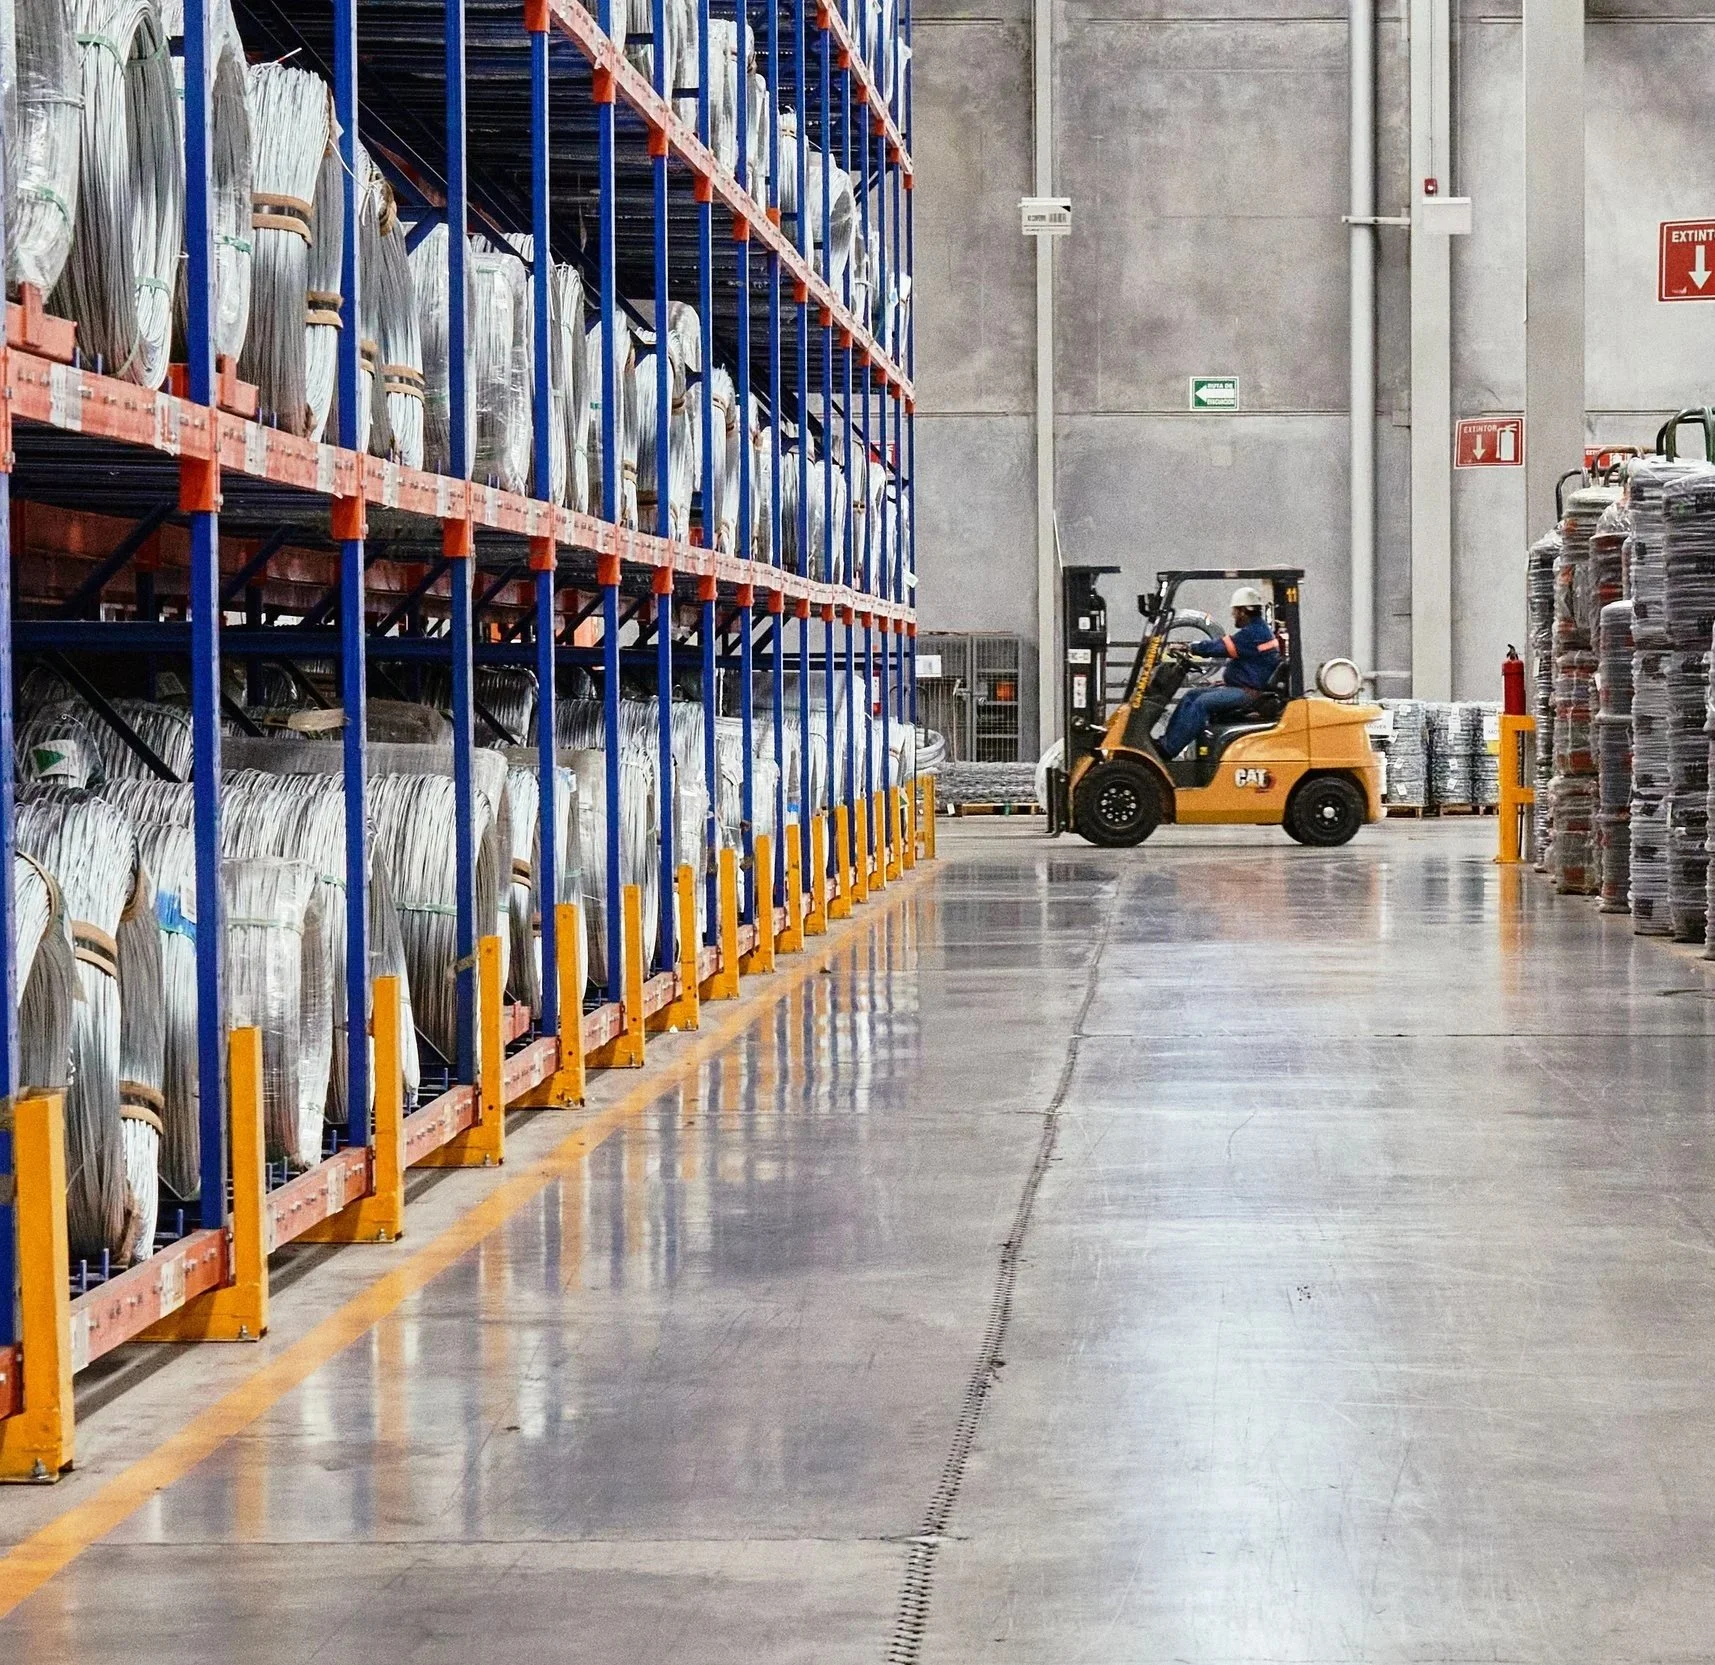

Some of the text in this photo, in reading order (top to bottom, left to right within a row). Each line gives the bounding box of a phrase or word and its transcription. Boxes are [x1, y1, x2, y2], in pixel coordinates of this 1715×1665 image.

[1672, 229, 1715, 242] EXTINT
[1463, 424, 1497, 434] EXTINTOR
[1235, 768, 1267, 788] CAT
